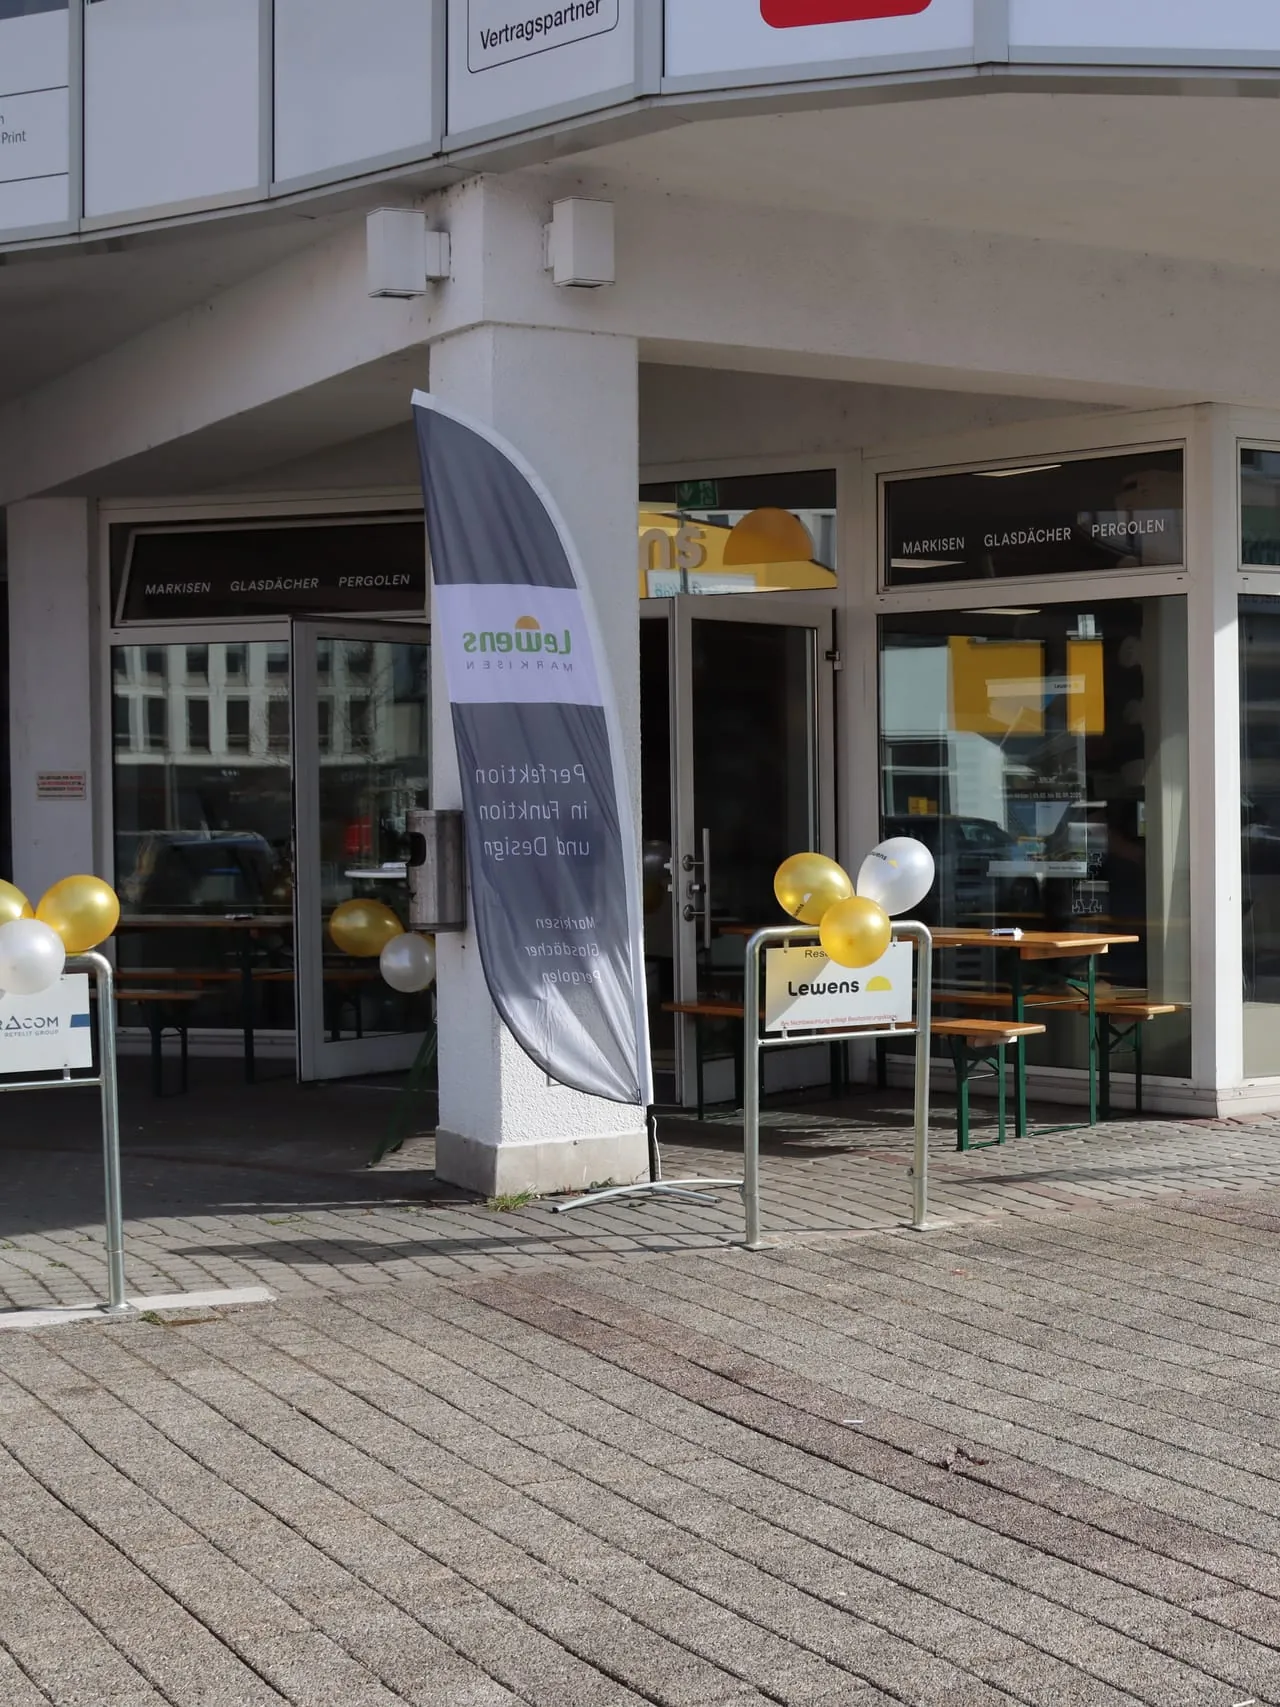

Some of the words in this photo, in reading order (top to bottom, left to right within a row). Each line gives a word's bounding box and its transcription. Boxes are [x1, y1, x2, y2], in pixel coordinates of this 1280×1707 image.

[480, 0, 601, 50] Vertragspartner
[1, 130, 27, 144] Print
[902, 537, 965, 555] MARKISEN
[984, 527, 1072, 548] GLASDÄCHER
[1091, 518, 1165, 538] PERGOLEN
[145, 581, 211, 596] MARKISEN
[230, 576, 319, 592] GLASDÄCHER
[338, 574, 411, 588] PERGOLEN
[788, 980, 860, 997] Lewens
